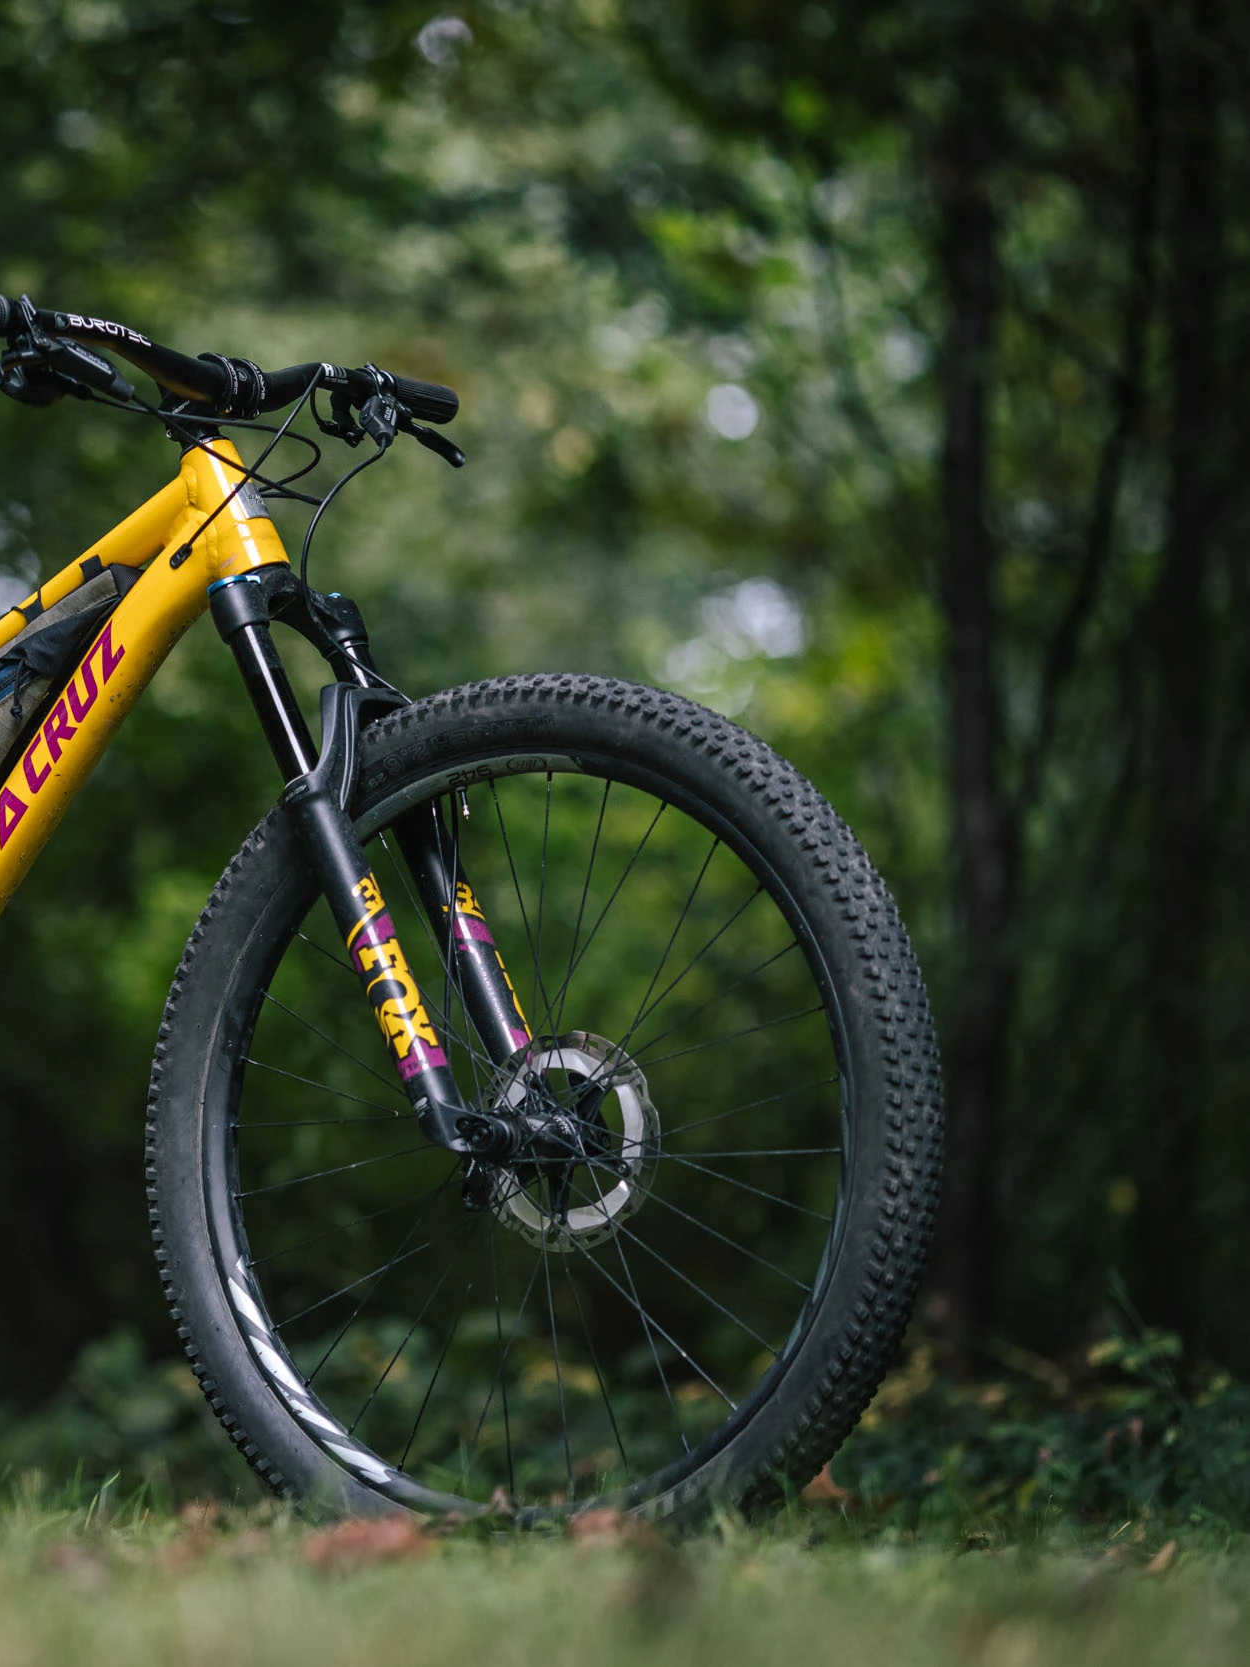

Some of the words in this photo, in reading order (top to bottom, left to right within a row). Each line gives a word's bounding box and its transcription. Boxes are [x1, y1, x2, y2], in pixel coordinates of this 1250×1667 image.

[67, 313, 152, 347] BURGTEC
[23, 619, 126, 795] CRUZ
[358, 938, 438, 1059] FOX
